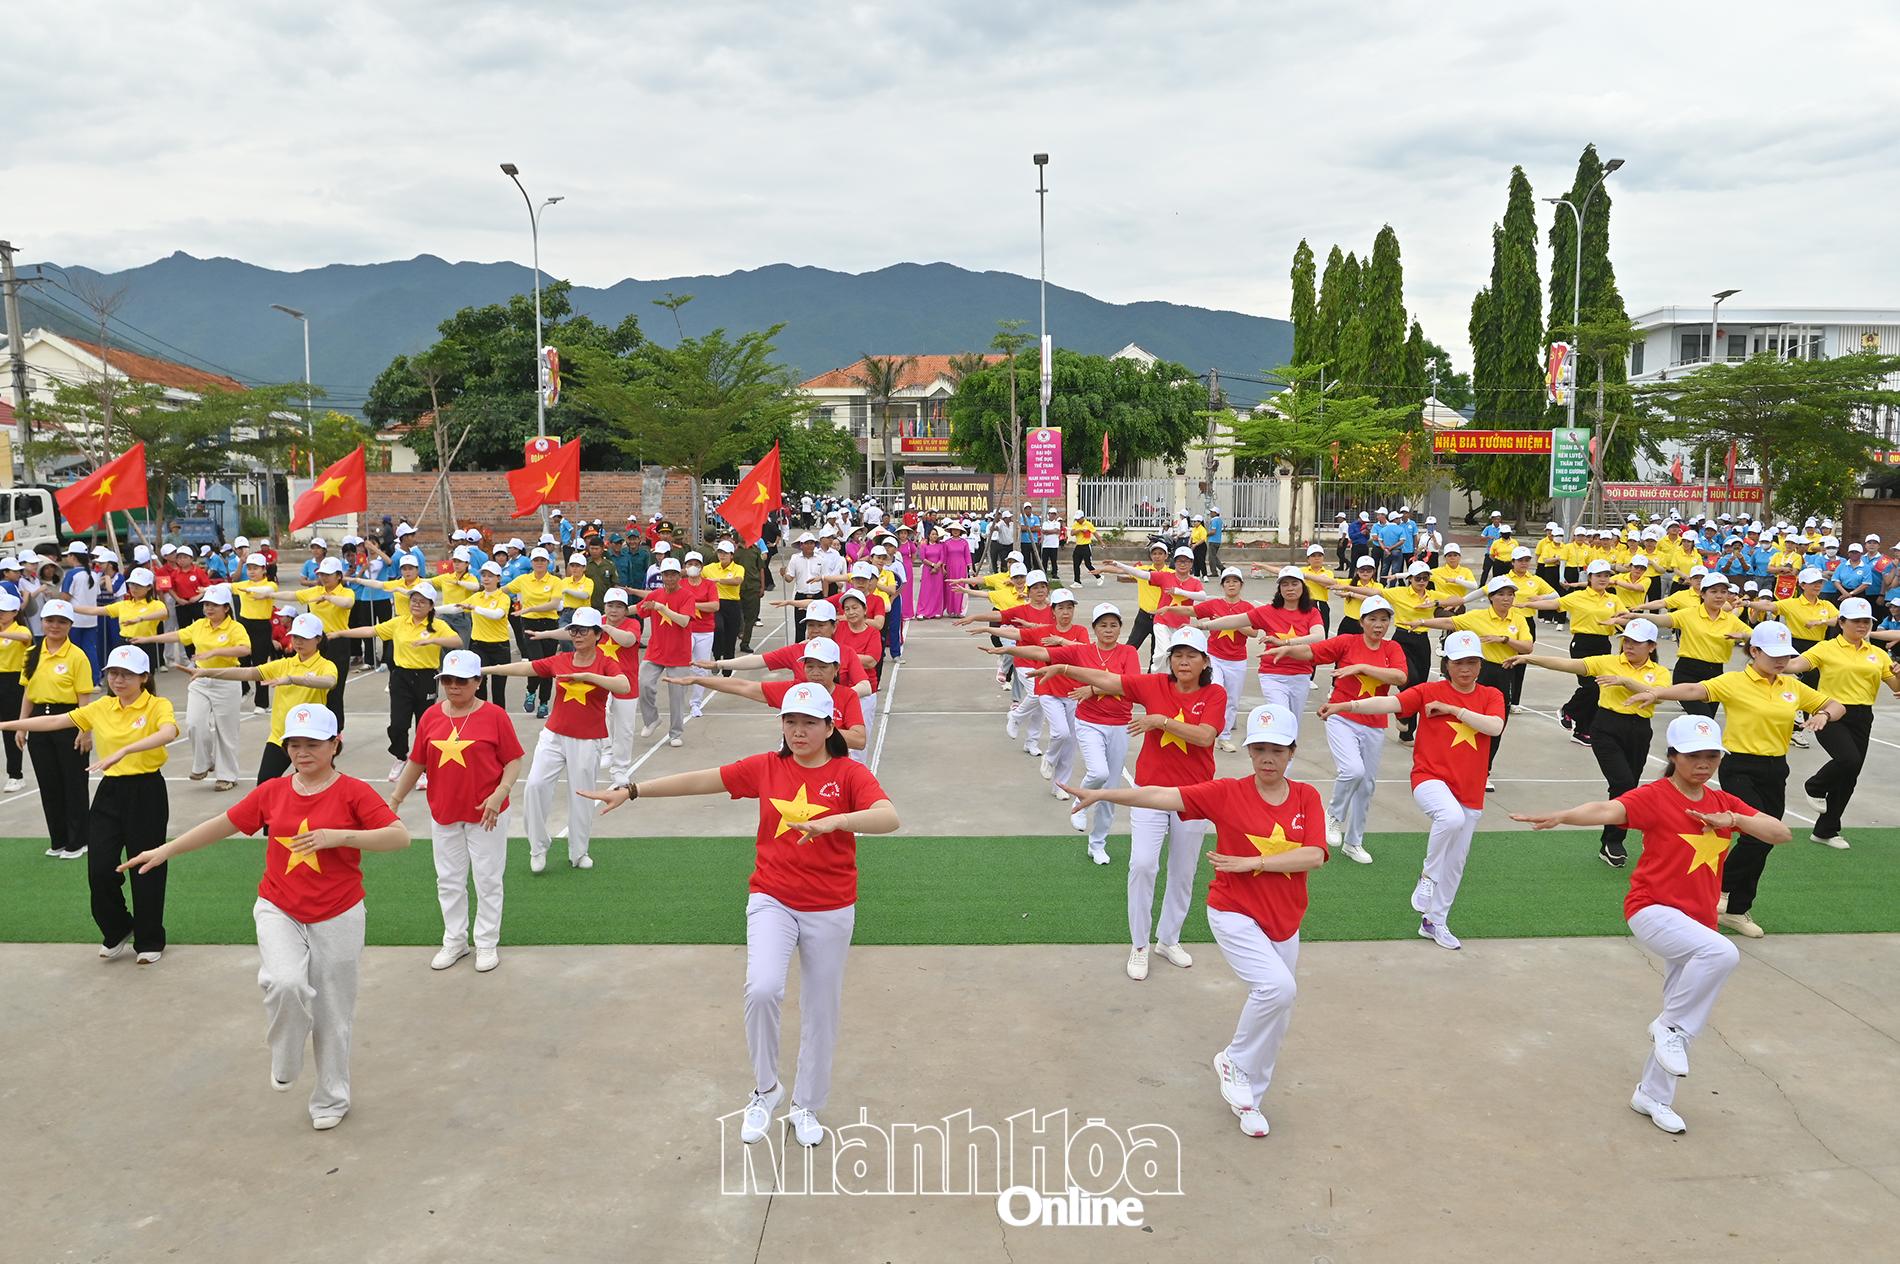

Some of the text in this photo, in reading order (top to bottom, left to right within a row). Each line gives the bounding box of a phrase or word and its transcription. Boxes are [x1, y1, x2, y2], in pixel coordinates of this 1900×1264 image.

[1459, 436, 1477, 449] BIA
[1479, 433, 1513, 449] TƯỞNG
[1515, 434, 1543, 451] NIỆM
[911, 480, 989, 492] ĐẢNG ỦY, ỦY BAN MTTQVN
[1623, 488, 1638, 498] ĐỜI
[1639, 487, 1658, 498] NHỚ
[1659, 488, 1671, 498] ƠN
[1673, 487, 1689, 498] CÁC
[1691, 489, 1706, 498] AN
[1733, 489, 1749, 500] LIỆT
[1751, 489, 1760, 499] SĨ
[910, 494, 988, 511] XÃ NAM NINH HÒA
